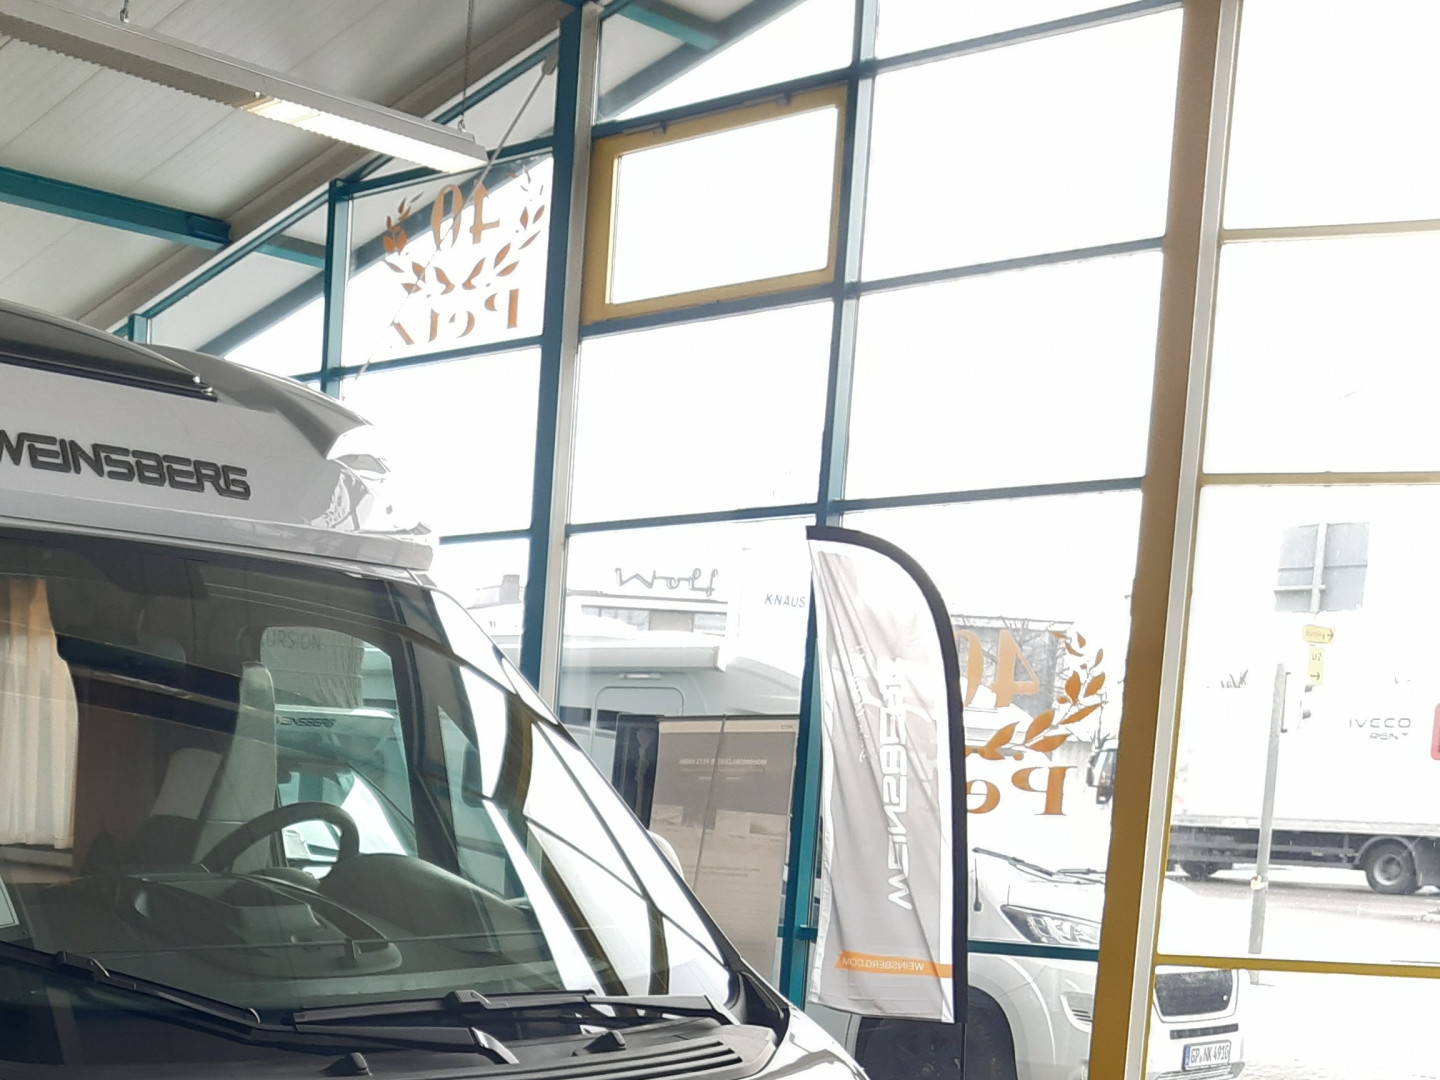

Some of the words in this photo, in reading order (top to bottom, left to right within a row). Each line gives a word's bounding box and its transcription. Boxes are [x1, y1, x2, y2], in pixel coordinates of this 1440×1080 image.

[615, 567, 719, 597] Wolf
[764, 592, 807, 608] KNAUS
[262, 629, 323, 650] URSION
[1349, 717, 1411, 729] IVECO
